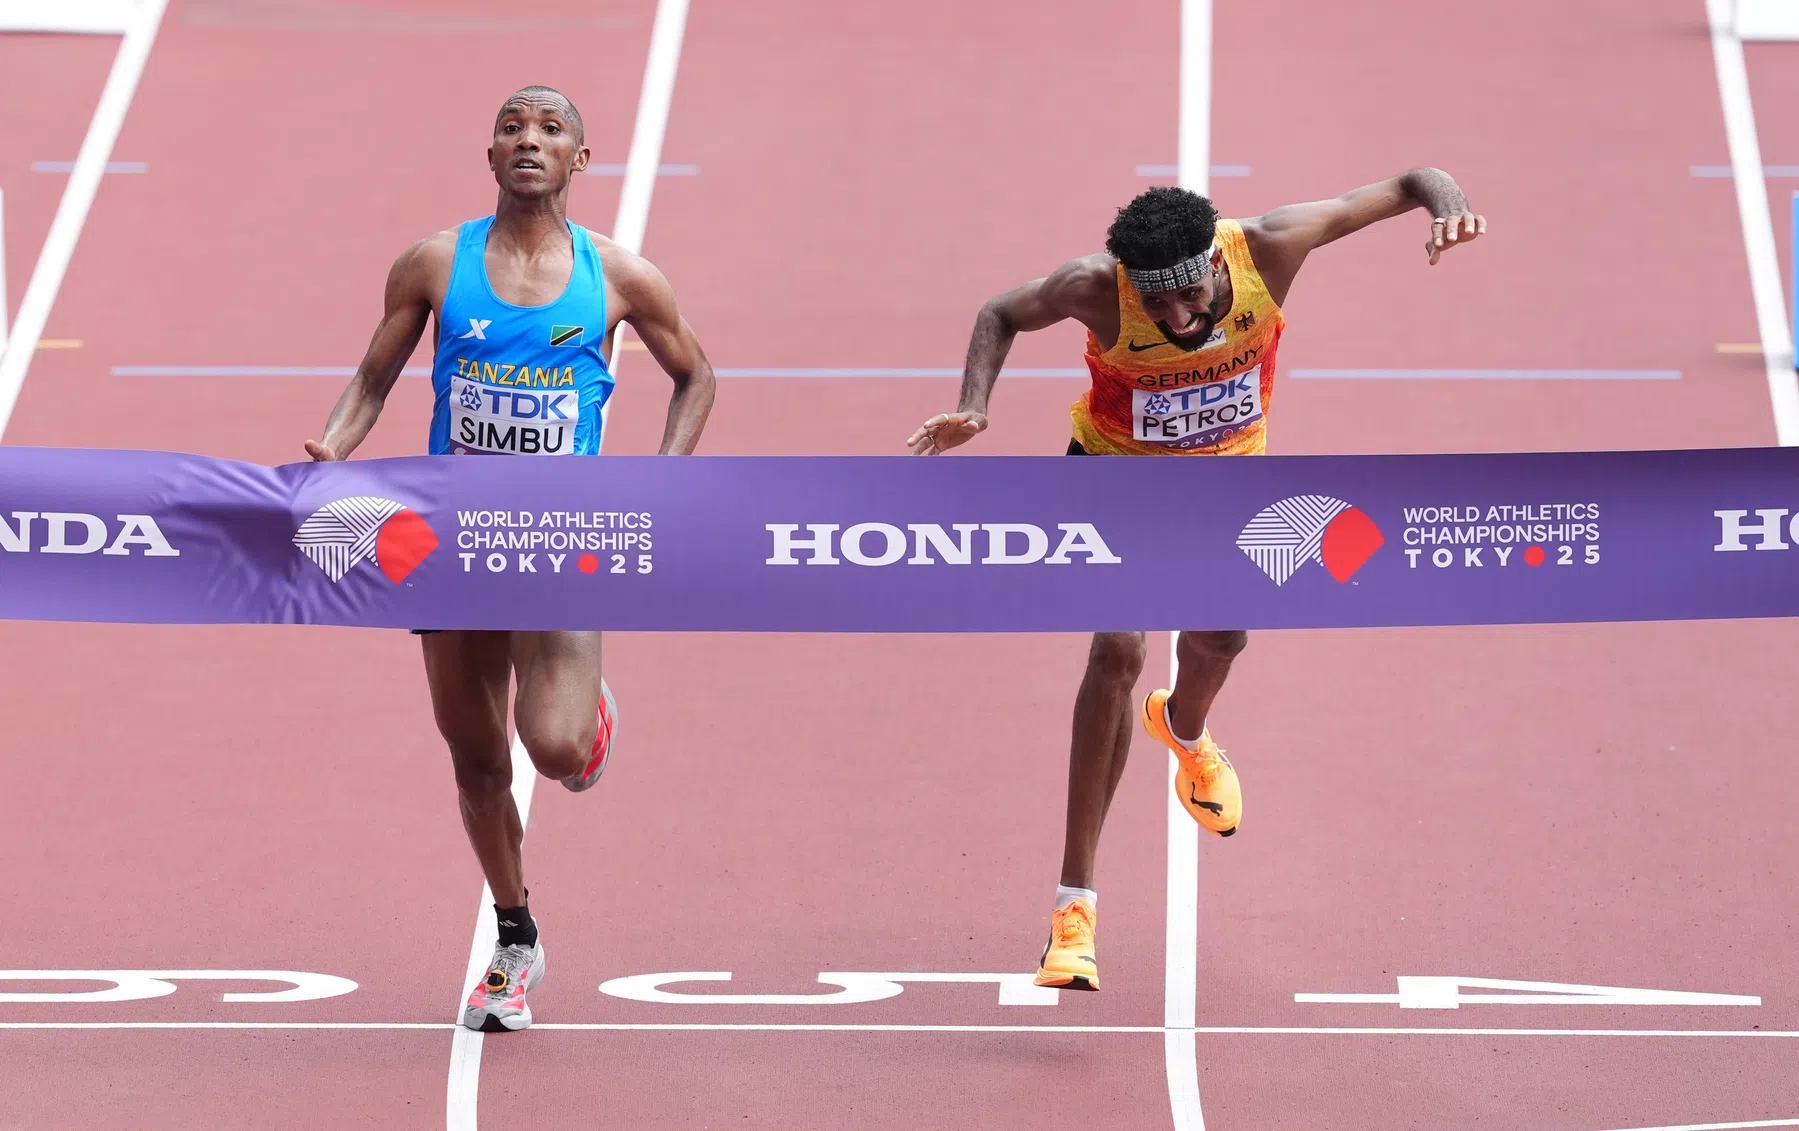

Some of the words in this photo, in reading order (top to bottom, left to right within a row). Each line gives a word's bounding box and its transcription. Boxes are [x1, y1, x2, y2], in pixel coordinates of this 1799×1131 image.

[457, 357, 575, 388] TANZANIA
[1137, 344, 1263, 387] GERMANY
[482, 388, 569, 420] TDK
[1170, 371, 1253, 411] TDK
[1142, 394, 1254, 437] PETROS
[460, 416, 563, 454] SIMBU
[457, 510, 534, 528] WORLD
[538, 511, 653, 529] ATHLETICS
[1403, 506, 1481, 524] WORLD
[1485, 503, 1600, 522] ATHLETICS
[457, 530, 653, 551] CHAMPIONSHIPS
[765, 522, 1122, 566] HONDA
[1403, 523, 1600, 546] CHAMPIONSHIPS
[598, 969, 1060, 1007] 5
[1294, 975, 1762, 1010] 4
